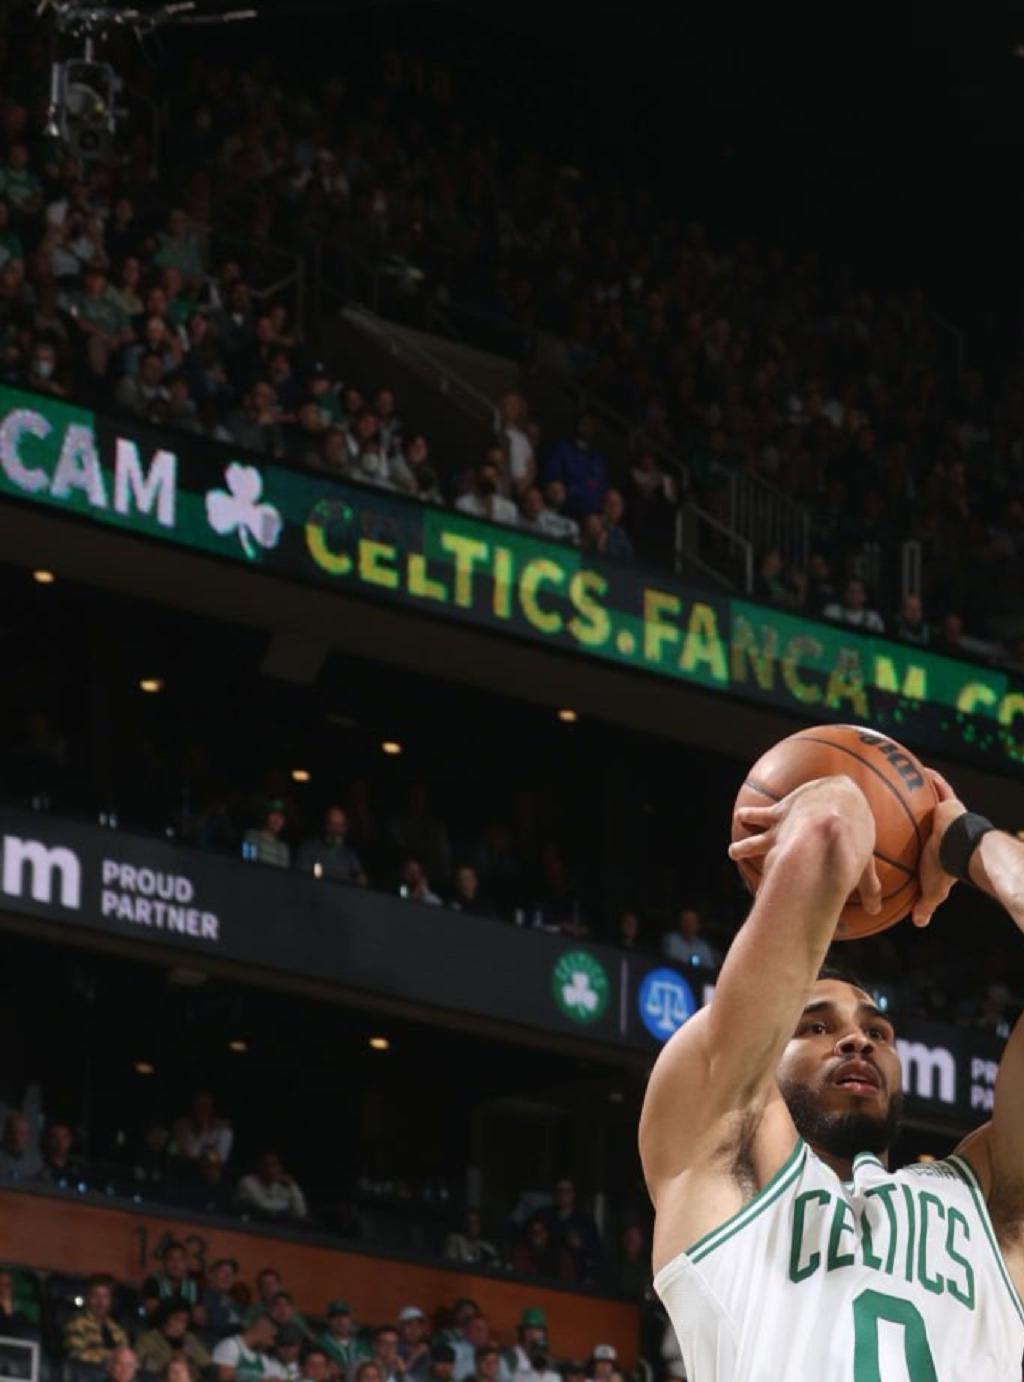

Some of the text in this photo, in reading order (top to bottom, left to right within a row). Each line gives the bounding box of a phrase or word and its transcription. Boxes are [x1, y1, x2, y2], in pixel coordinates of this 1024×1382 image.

[102, 859, 194, 904] PROUD
[101, 889, 219, 940] PARTNER
[788, 1183, 976, 1312] CELTICS
